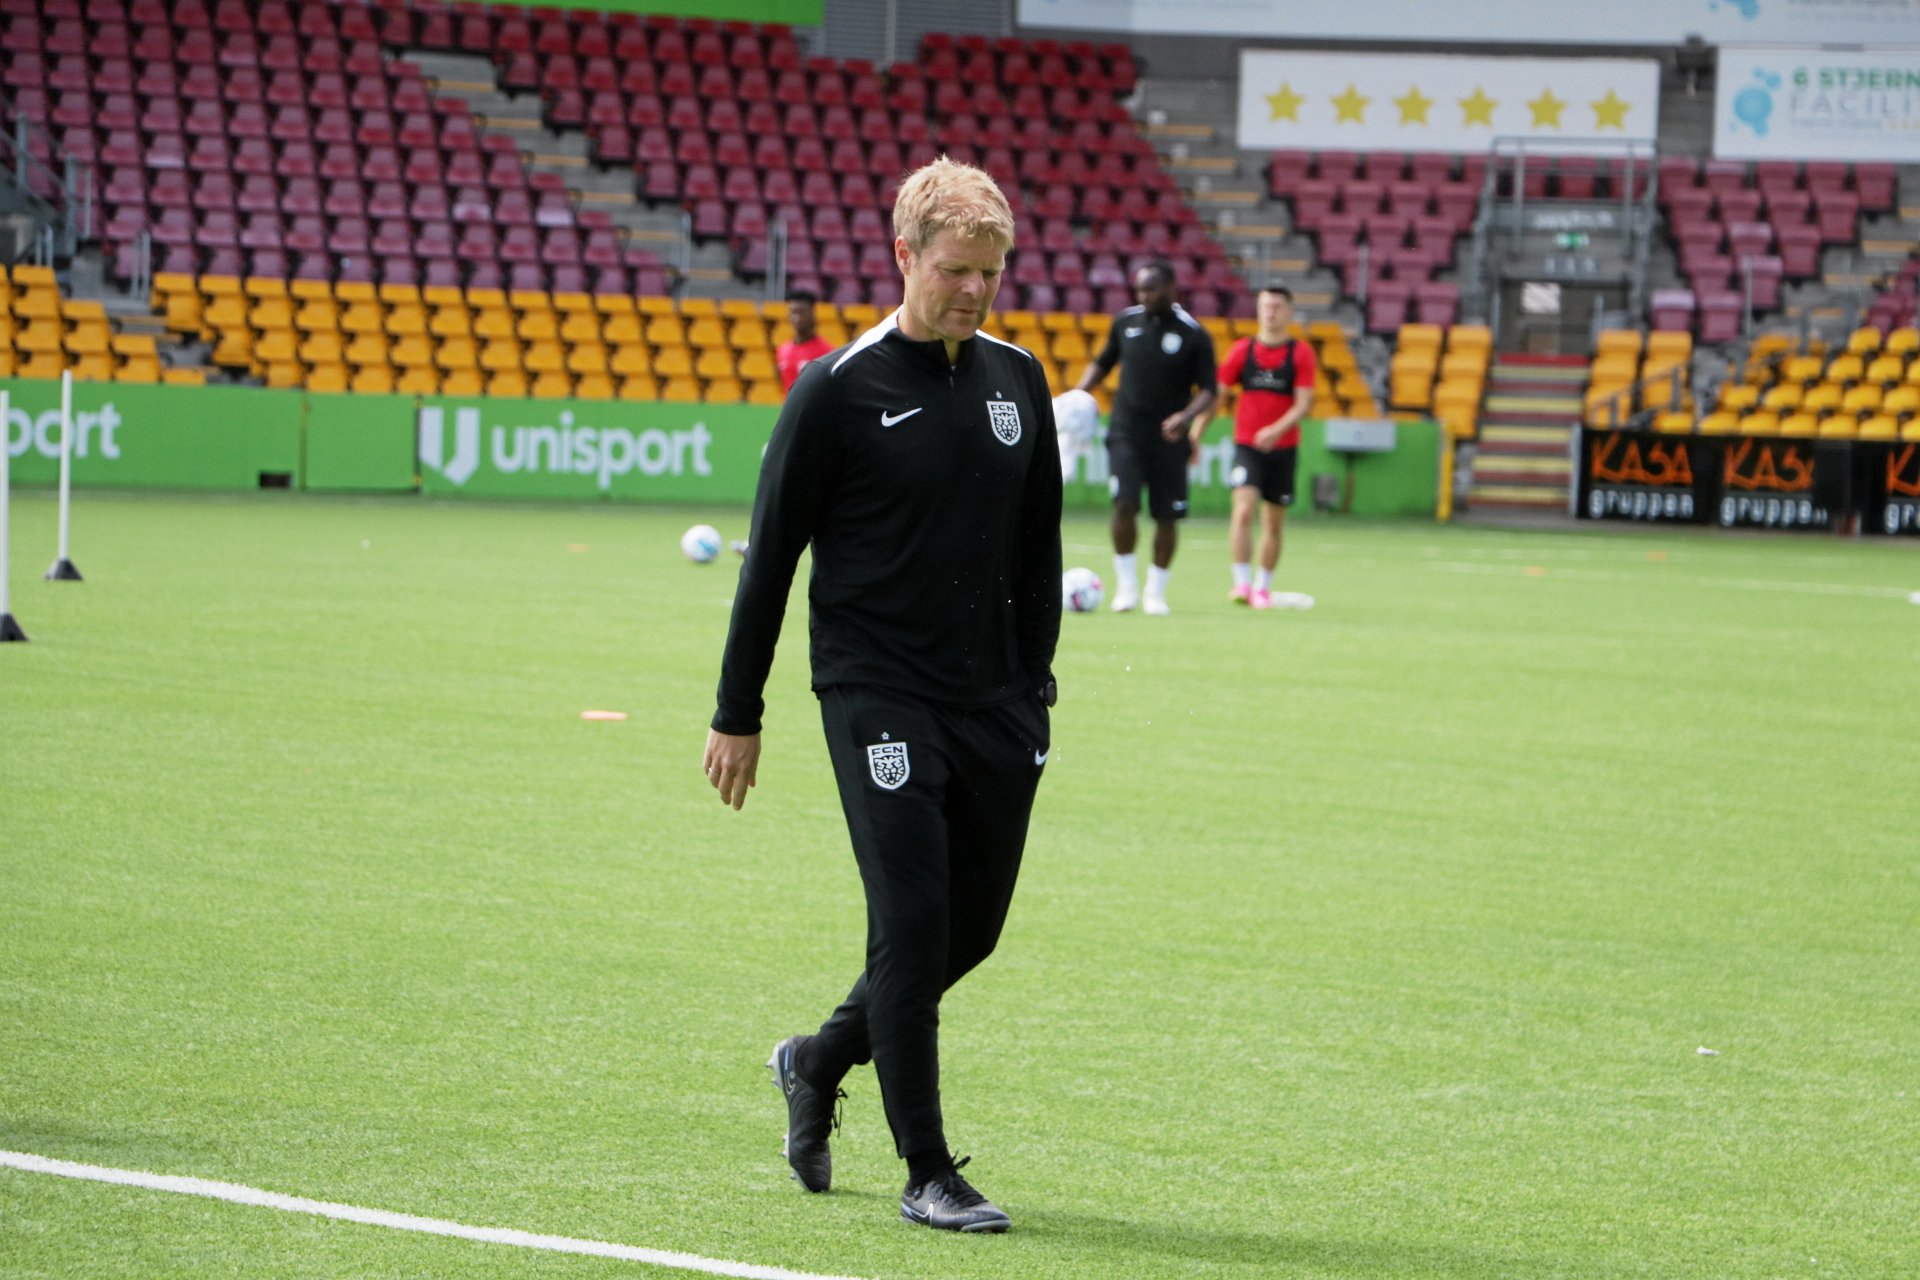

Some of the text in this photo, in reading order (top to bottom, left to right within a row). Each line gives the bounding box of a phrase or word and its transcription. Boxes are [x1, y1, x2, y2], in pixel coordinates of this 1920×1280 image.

[1793, 67, 1808, 87] 6
[990, 404, 1015, 412] FCN
[491, 410, 713, 490] unisport
[1591, 431, 1694, 486] KASA
[1589, 488, 1694, 520] gruppen
[871, 745, 903, 755] FCN
